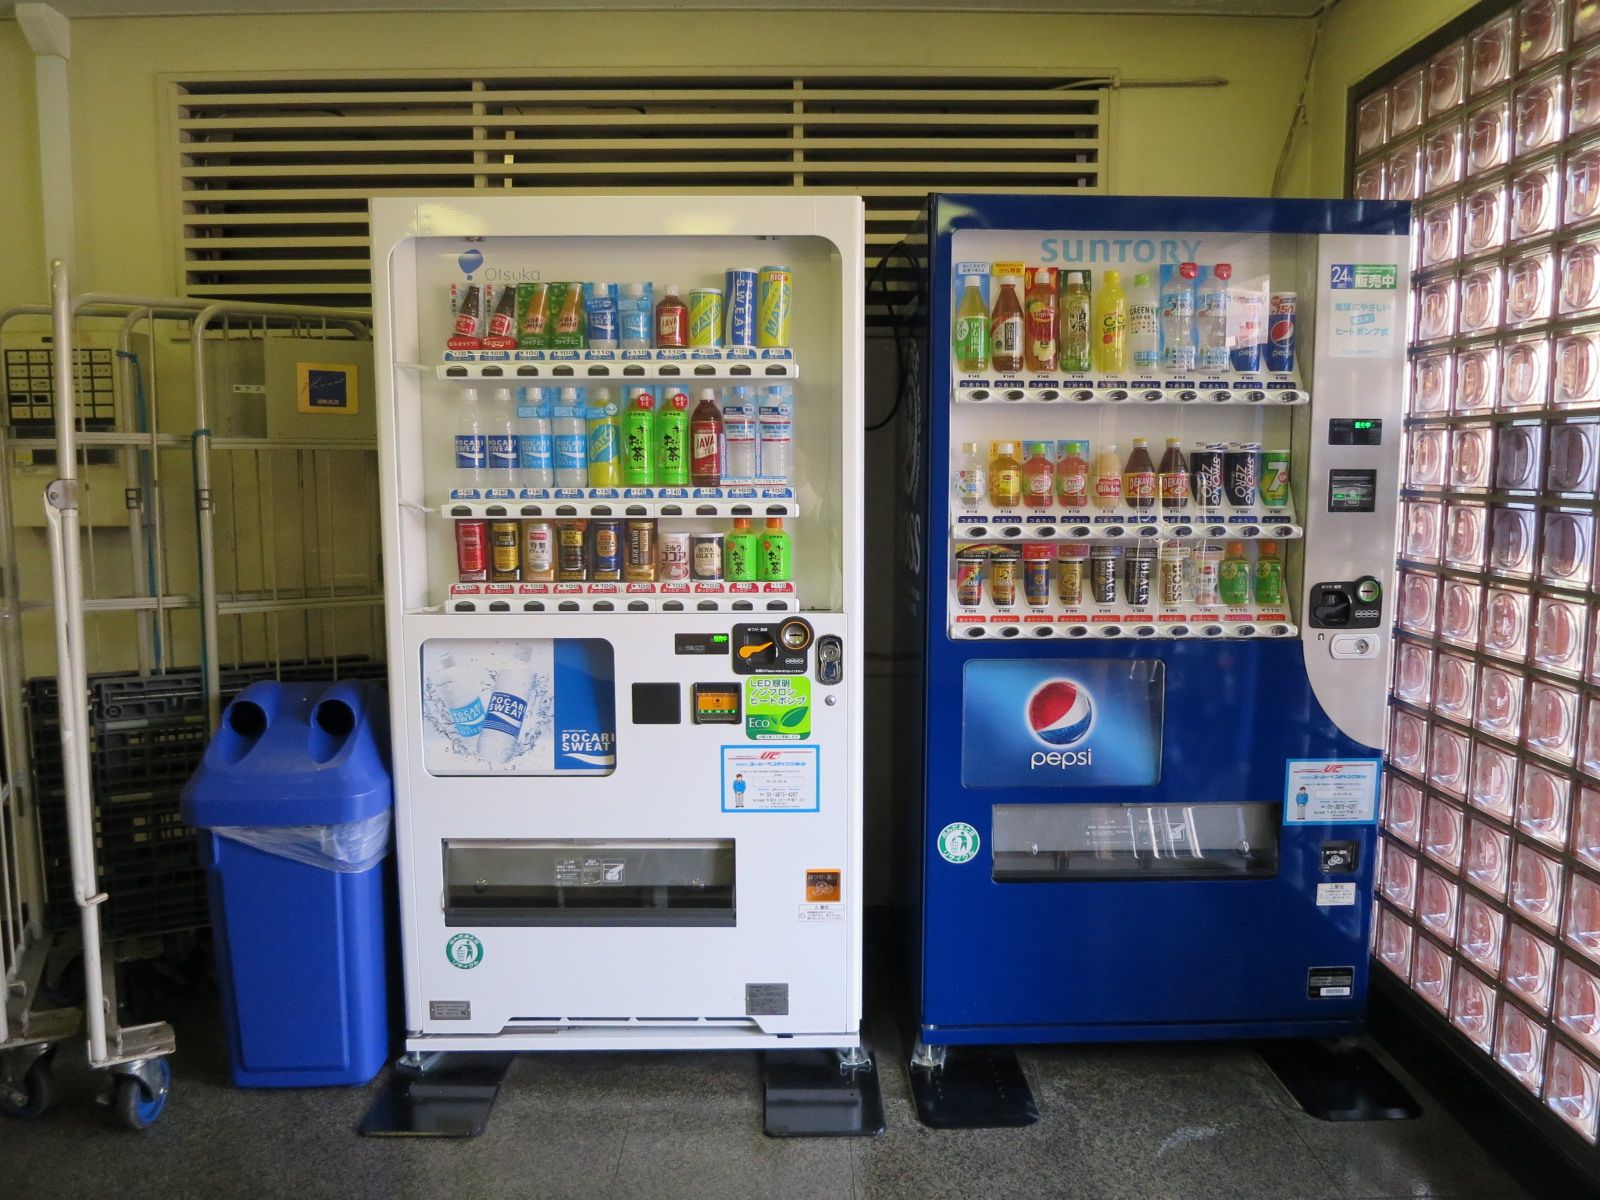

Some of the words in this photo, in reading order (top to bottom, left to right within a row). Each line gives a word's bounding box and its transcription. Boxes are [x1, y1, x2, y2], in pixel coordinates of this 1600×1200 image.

[1041, 238, 1202, 263] SUNTORY
[485, 267, 540, 281] Otsuka
[735, 279, 745, 337] SWEAT
[1129, 306, 1150, 316] GREEN
[1235, 463, 1247, 498] ZERO
[661, 551, 686, 562] ココア
[750, 679, 790, 688] LED照明
[751, 688, 796, 696] ノンフロン
[489, 703, 523, 719] SWEAT
[491, 695, 528, 714] POCARI
[562, 733, 615, 743] POCARI
[562, 742, 611, 752] SWEAT
[1031, 748, 1092, 770] pepsi
